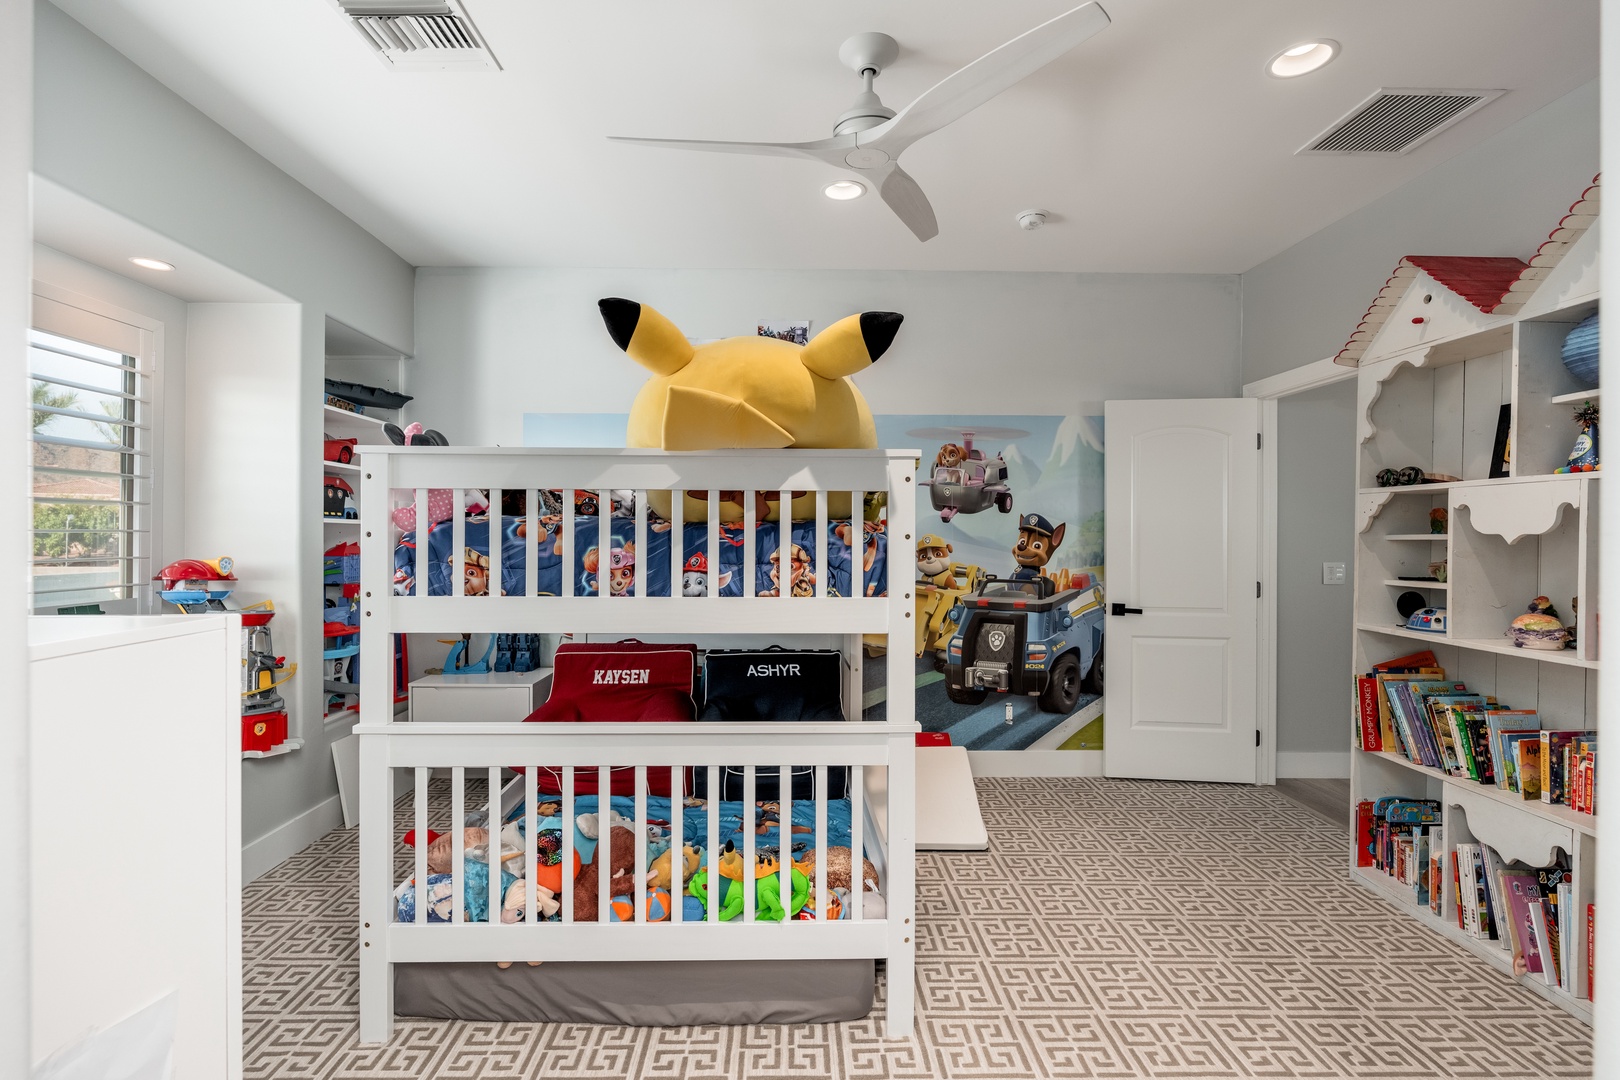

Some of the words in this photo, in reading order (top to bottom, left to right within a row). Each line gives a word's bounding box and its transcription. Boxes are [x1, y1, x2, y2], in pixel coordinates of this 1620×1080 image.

[593, 669, 650, 685] KAYSEN
[746, 663, 802, 677] ASHYR
[1363, 682, 1373, 715] MONKEY
[1498, 717, 1522, 726] Today
[1365, 716, 1376, 749] GRUMPY
